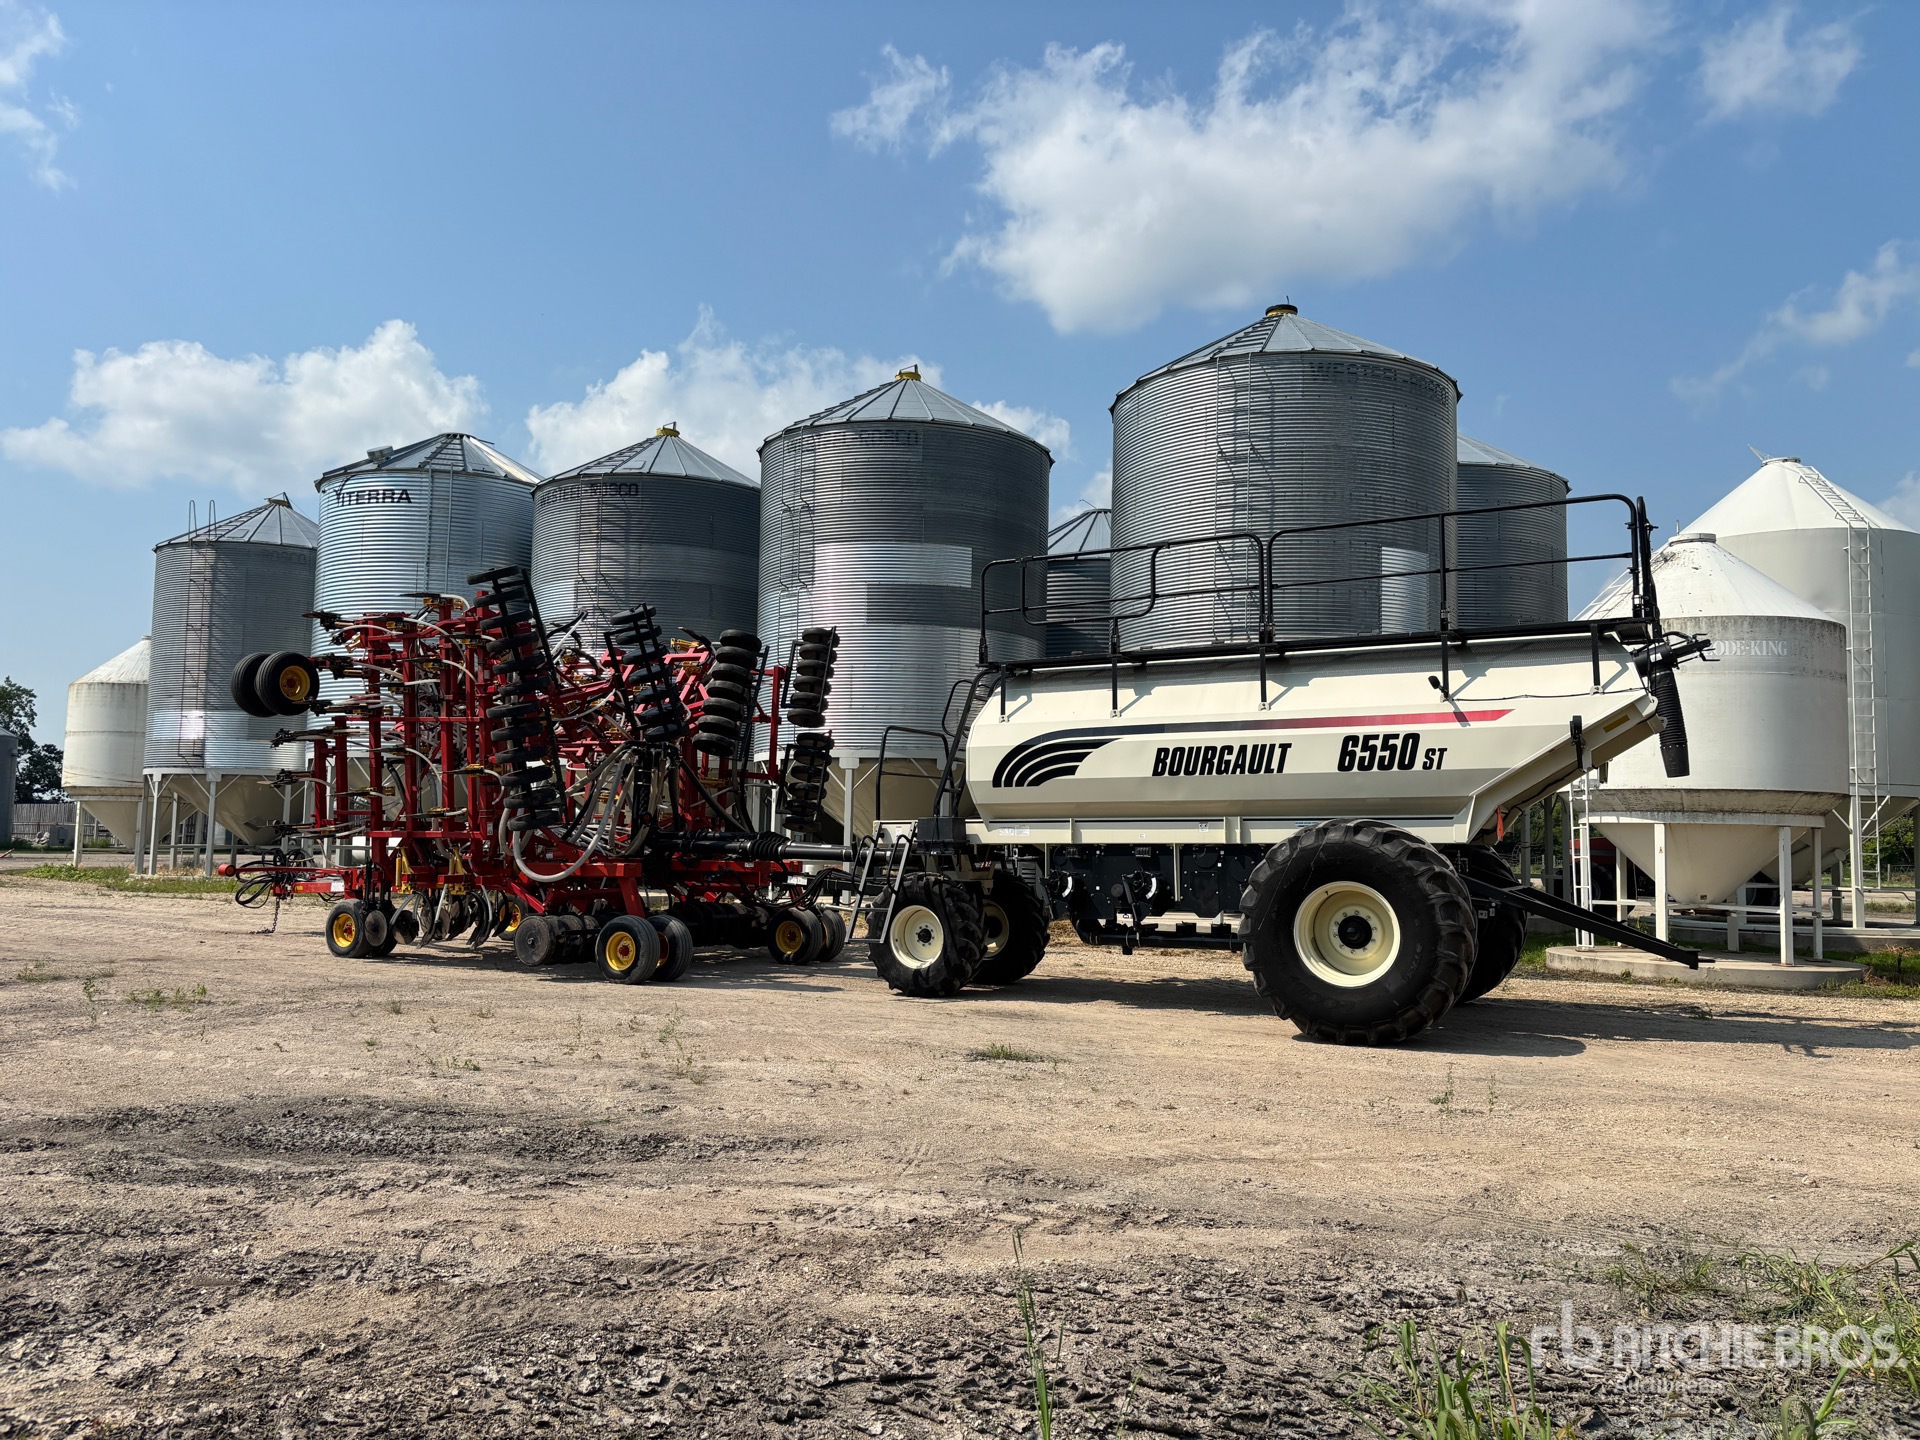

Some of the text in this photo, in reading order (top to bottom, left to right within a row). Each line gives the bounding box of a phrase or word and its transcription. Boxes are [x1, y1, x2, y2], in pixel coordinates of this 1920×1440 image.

[333, 488, 413, 507] VITERRA
[1705, 640, 1788, 656] ODE-KING
[1151, 732, 1448, 777] BOURGAULT 6550 ST
